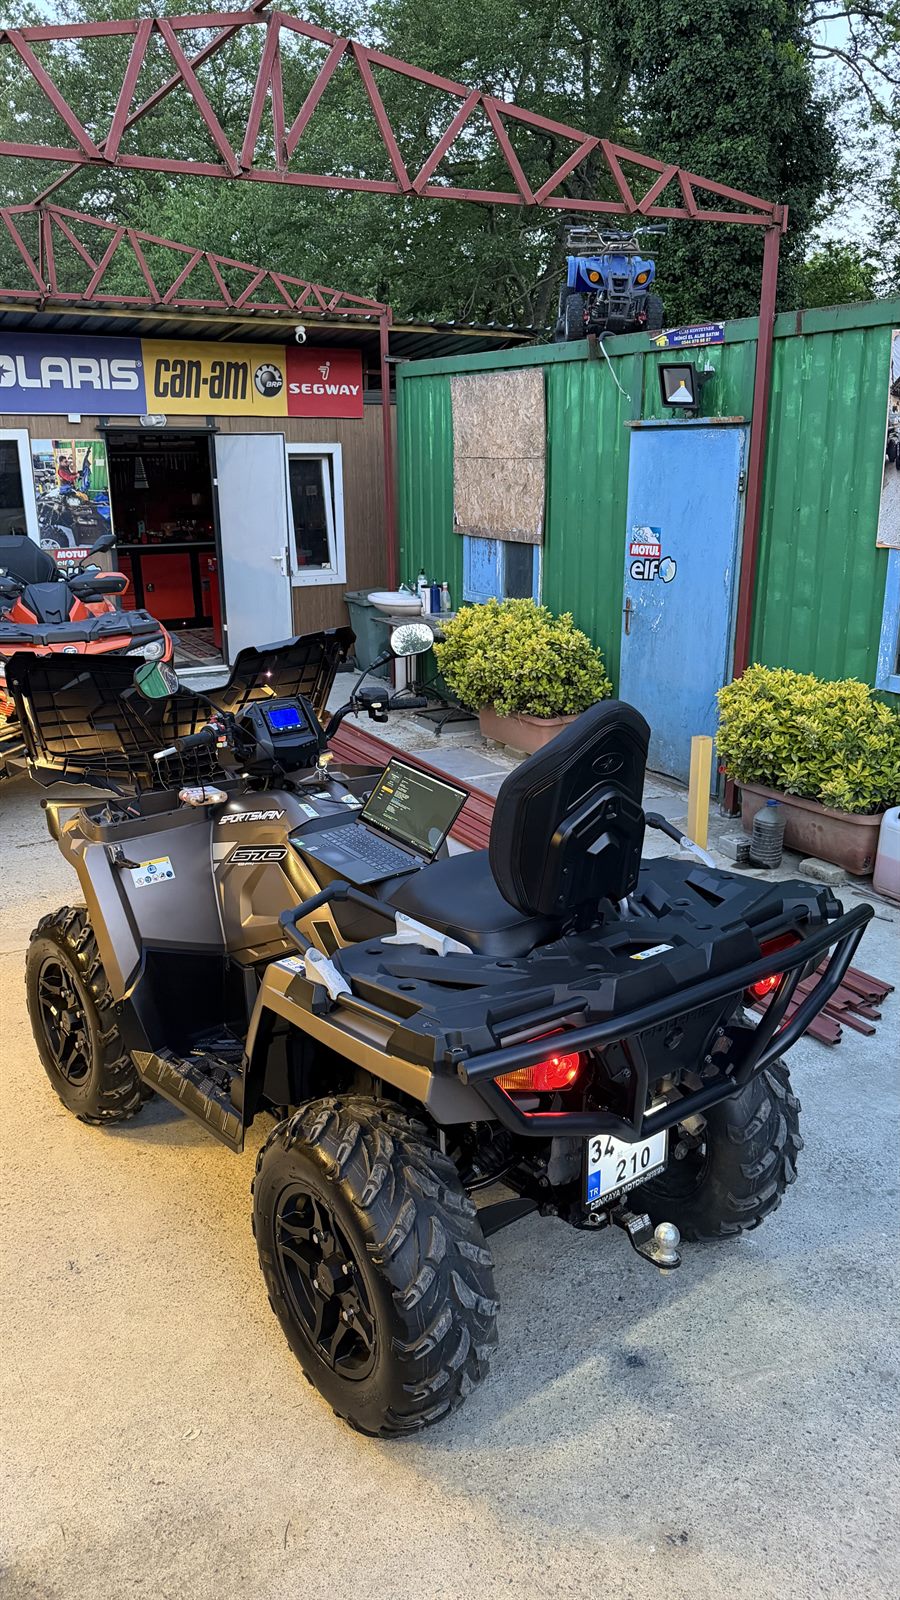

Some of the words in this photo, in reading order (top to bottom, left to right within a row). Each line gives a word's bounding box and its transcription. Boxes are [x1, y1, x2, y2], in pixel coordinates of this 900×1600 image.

[265, 380, 282, 389] BRP
[289, 382, 360, 396] SEGWAY
[631, 544, 660, 556] MOTUL
[631, 560, 659, 580] elf
[218, 810, 285, 825] SPORTSMAN
[231, 849, 288, 862] 570
[591, 1136, 615, 1163] 34
[616, 1146, 651, 1183] 210
[589, 1187, 599, 1198] TR
[621, 1177, 644, 1195] MOTOR
